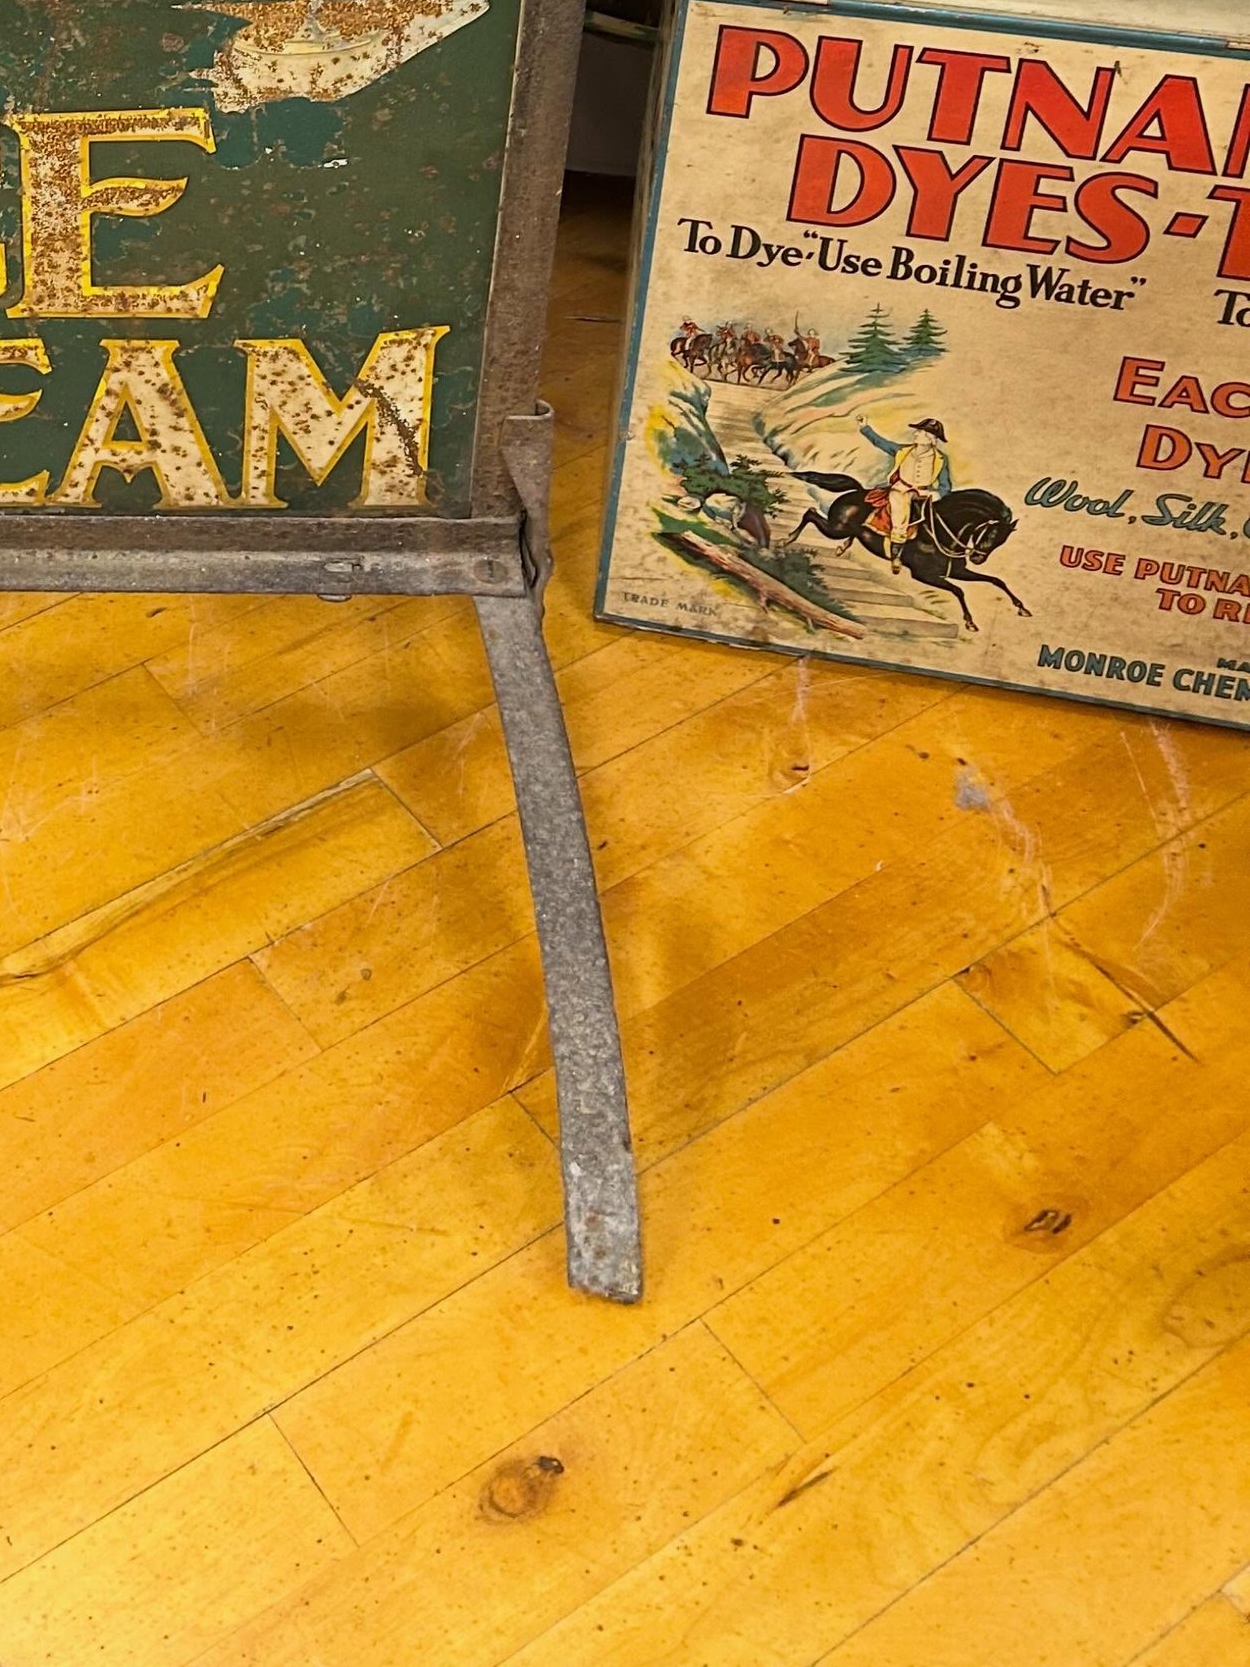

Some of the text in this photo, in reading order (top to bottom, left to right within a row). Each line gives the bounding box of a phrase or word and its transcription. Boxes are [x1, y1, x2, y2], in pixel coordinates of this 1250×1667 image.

[706, 24, 1250, 179] PUTNA
[677, 217, 723, 255] To
[886, 246, 1023, 310] Boiling
[1024, 477, 1137, 525] Wool,
[1141, 493, 1238, 540] Silk,
[1059, 544, 1126, 576] USE
[623, 591, 719, 616] TRADE MARK
[1155, 587, 1206, 615] TO
[1037, 644, 1166, 687] MONROE
